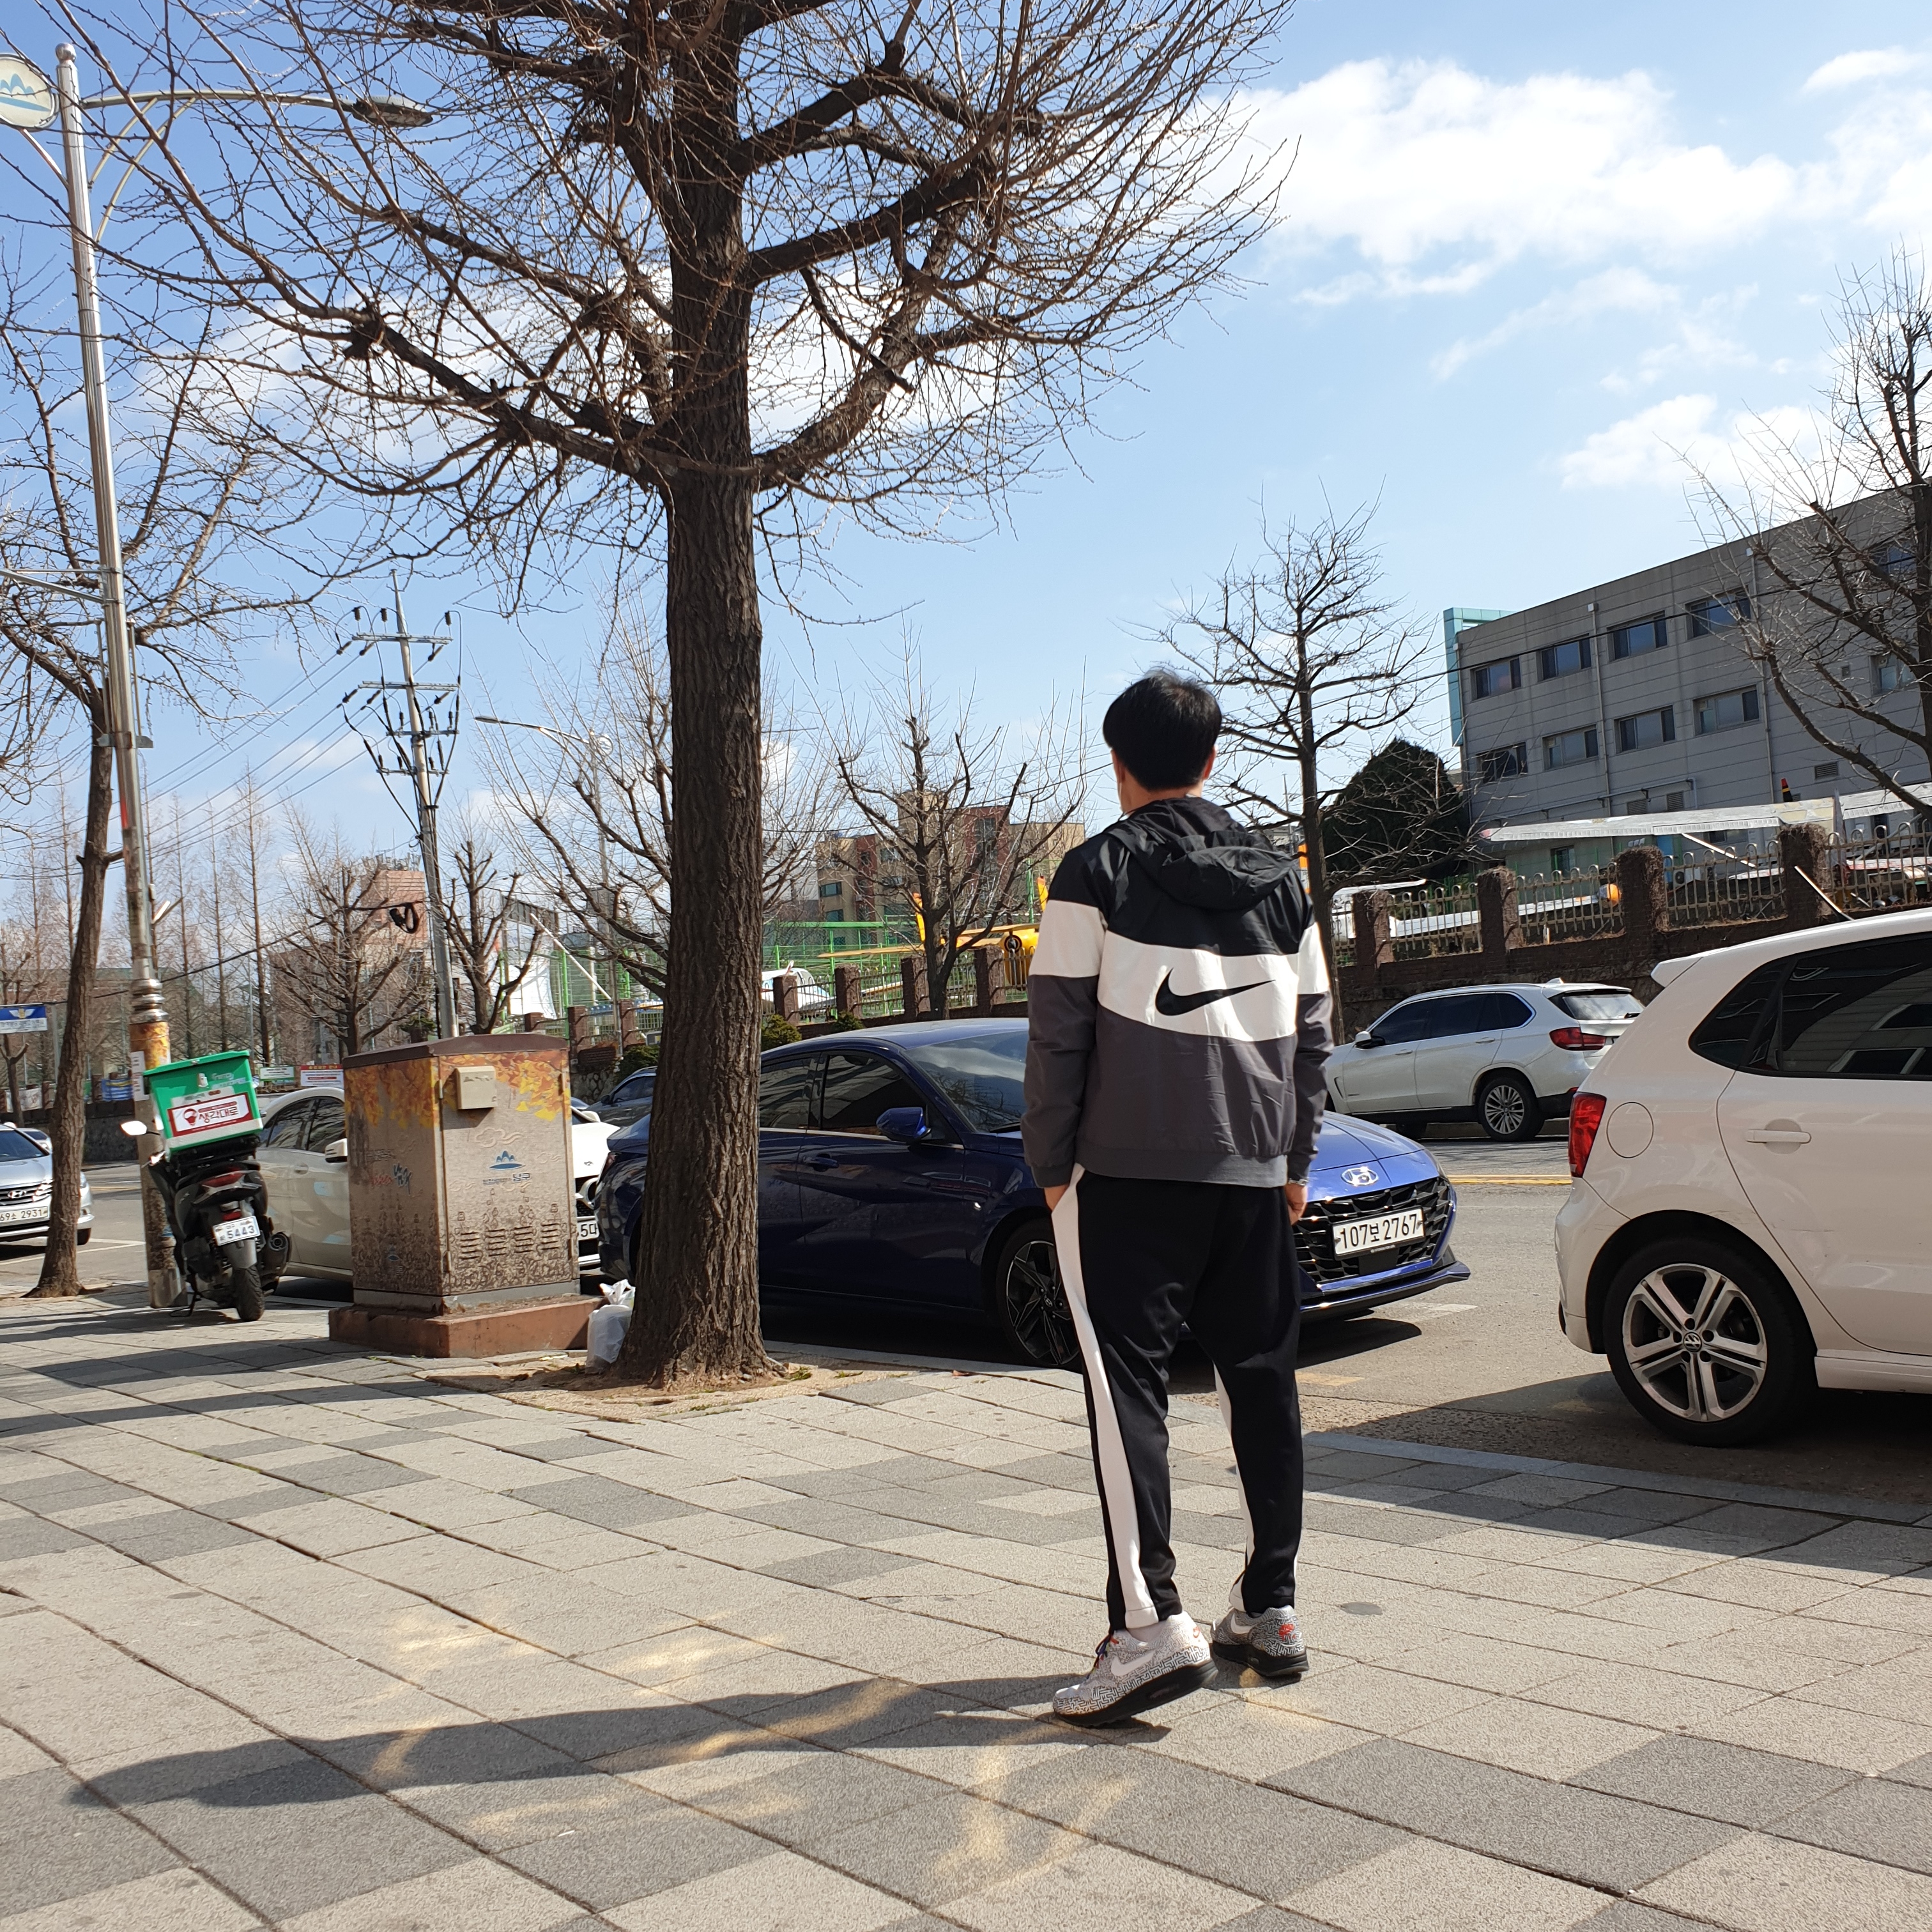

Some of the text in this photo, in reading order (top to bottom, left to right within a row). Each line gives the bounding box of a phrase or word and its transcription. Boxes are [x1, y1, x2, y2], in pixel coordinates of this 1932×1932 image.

[199, 1107, 239, 1123] 생각대로
[513, 1173, 530, 1182] 남구
[21, 1209, 42, 1218] 2931
[227, 1225, 255, 1239] 5443
[578, 1223, 597, 1238] 5다
[1340, 1213, 1417, 1249] 107보2767
